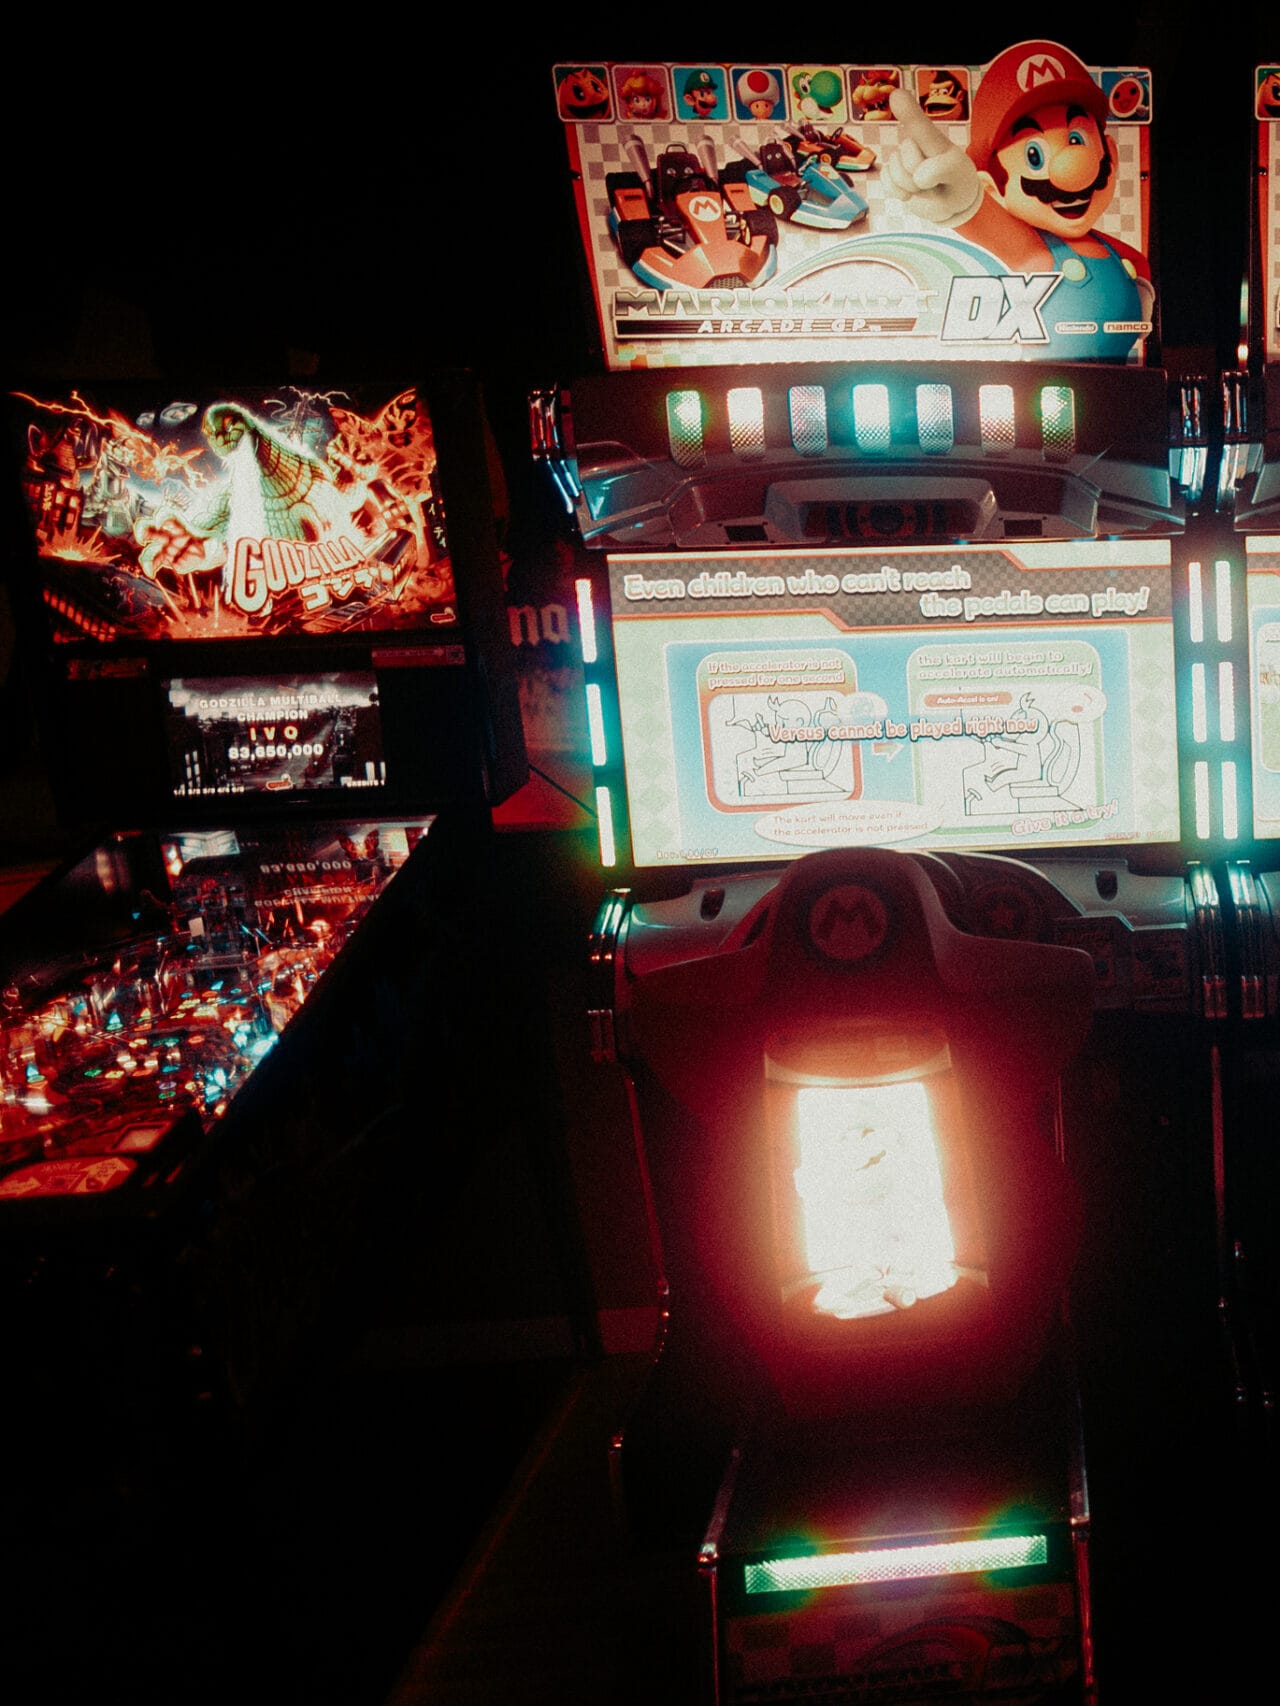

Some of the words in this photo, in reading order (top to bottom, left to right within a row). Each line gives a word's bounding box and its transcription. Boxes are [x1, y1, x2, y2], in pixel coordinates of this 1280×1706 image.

[940, 273, 1062, 343] DX
[697, 318, 813, 334] ARCADE
[1107, 322, 1149, 332] namco
[234, 536, 367, 613] GODZILLA
[300, 567, 376, 611] ゴジラ
[624, 574, 684, 600] Even
[688, 571, 782, 599] children
[788, 571, 838, 595] who
[841, 569, 900, 594] can't
[903, 567, 971, 593] reach
[919, 593, 962, 618] the
[965, 592, 1042, 621] pedals
[1045, 593, 1089, 616] can
[1091, 587, 1150, 618] play!
[720, 662, 740, 674] the
[741, 659, 808, 672] accelerator
[820, 658, 842, 670] not
[918, 654, 943, 667] the
[945, 652, 975, 666] kart
[979, 651, 1002, 664] will
[1006, 651, 1046, 666] begin
[1048, 650, 1064, 662] to
[918, 666, 994, 680] accelerate
[995, 663, 1093, 678] automatically!
[708, 674, 758, 690] pressed
[758, 673, 777, 685] for
[777, 673, 801, 684] one
[802, 671, 845, 684] second
[199, 697, 266, 710] GODZILLA
[270, 693, 343, 706] MULTIBALL
[237, 709, 309, 722] CHAMPION
[768, 723, 825, 743] Versus
[827, 723, 883, 740] cannot
[885, 719, 907, 738] be
[910, 718, 962, 741] played
[964, 717, 1005, 738] right
[1006, 718, 1040, 735] now
[773, 815, 792, 825] The
[795, 814, 816, 825] kart
[820, 813, 836, 823] will
[838, 813, 866, 822] move
[868, 812, 894, 821] even
[1011, 816, 1051, 836] Give
[1053, 811, 1069, 827] it
[1071, 811, 1086, 825] a
[1086, 799, 1119, 820] try!
[773, 827, 791, 837] the
[794, 826, 853, 837] accelerator
[866, 824, 884, 834] not
[886, 822, 929, 834] pressed
